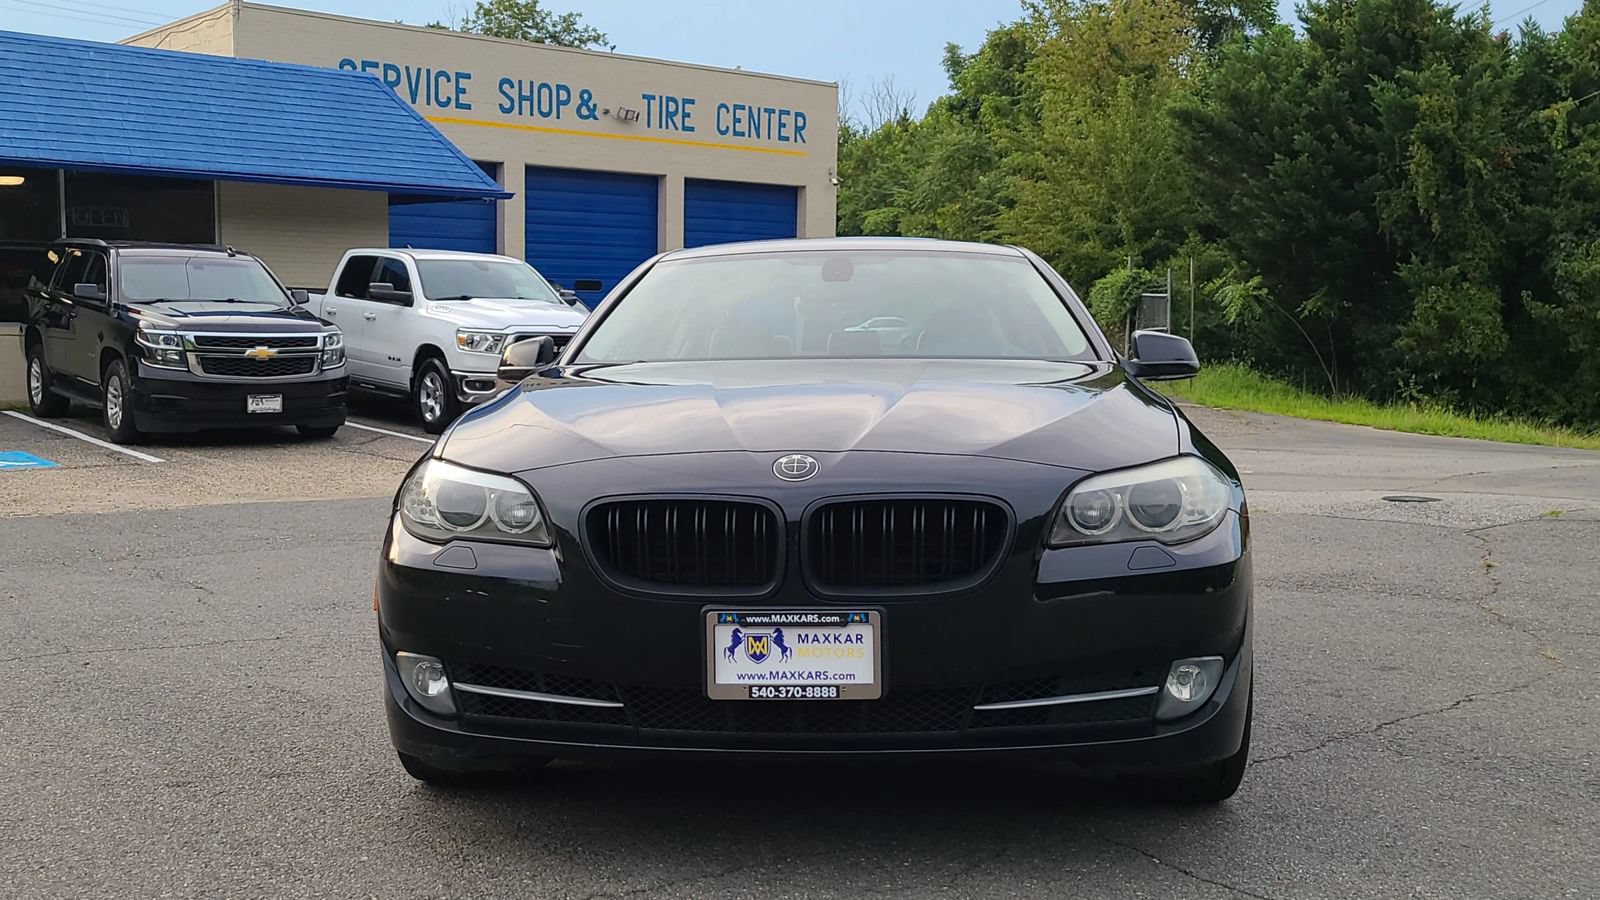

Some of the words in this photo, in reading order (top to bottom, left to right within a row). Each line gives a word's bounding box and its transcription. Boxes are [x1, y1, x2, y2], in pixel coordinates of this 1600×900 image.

[642, 93, 696, 132] TIRE
[716, 103, 807, 144] CENTER
[76, 208, 127, 225] OPEN
[746, 614, 840, 623] www.MAXKARS.com
[797, 633, 864, 645] MAXKAR
[797, 647, 865, 658] MOTORS
[736, 670, 856, 681] www.MAXKARS.com
[751, 686, 837, 698] 540-370-8888
